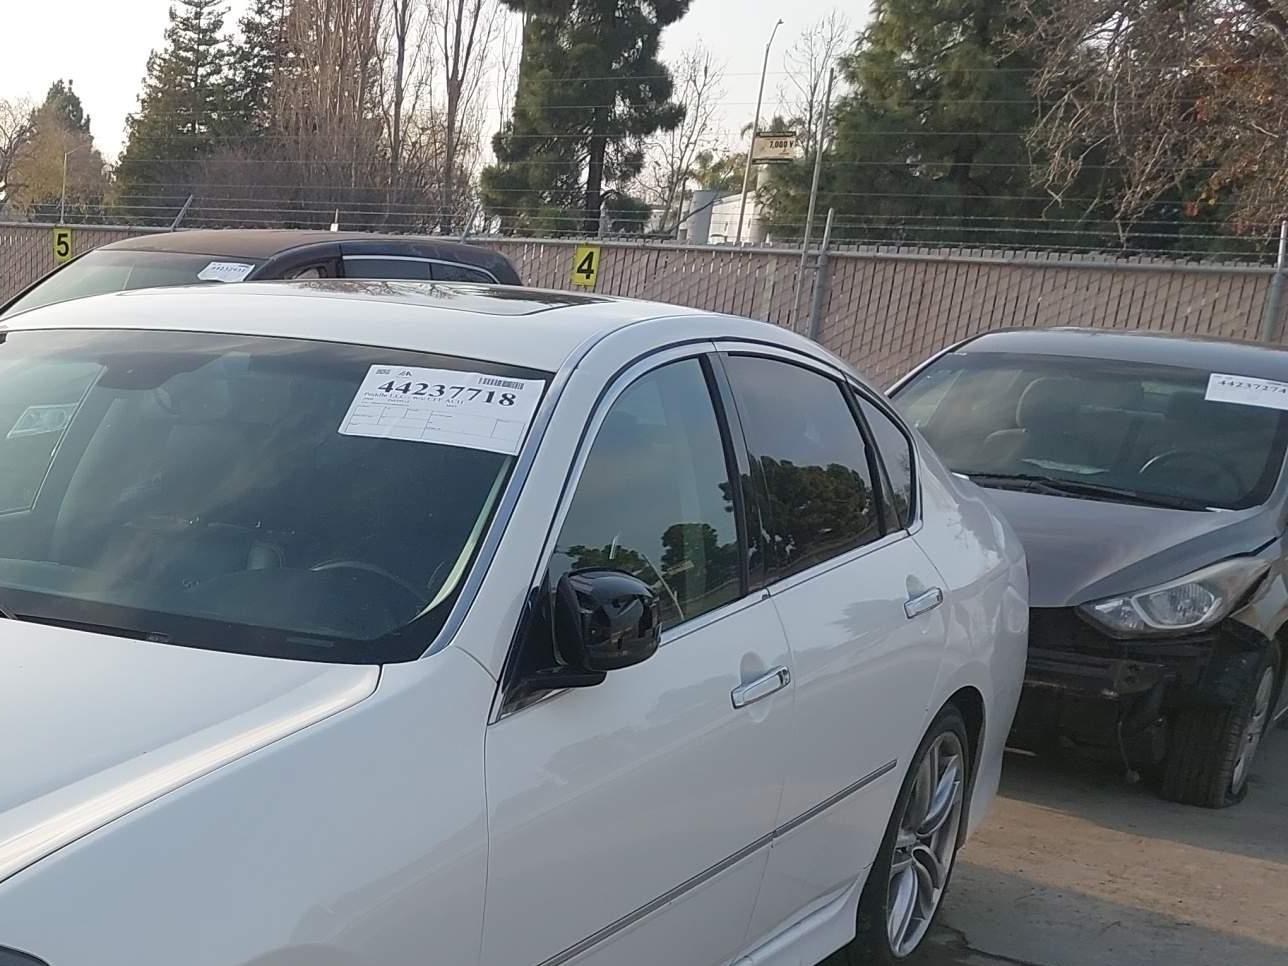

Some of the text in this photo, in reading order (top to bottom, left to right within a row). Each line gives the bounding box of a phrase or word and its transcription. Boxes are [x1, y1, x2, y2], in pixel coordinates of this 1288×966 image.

[57, 233, 70, 257] 5
[576, 251, 595, 280] 4
[377, 379, 518, 408] 44237718
